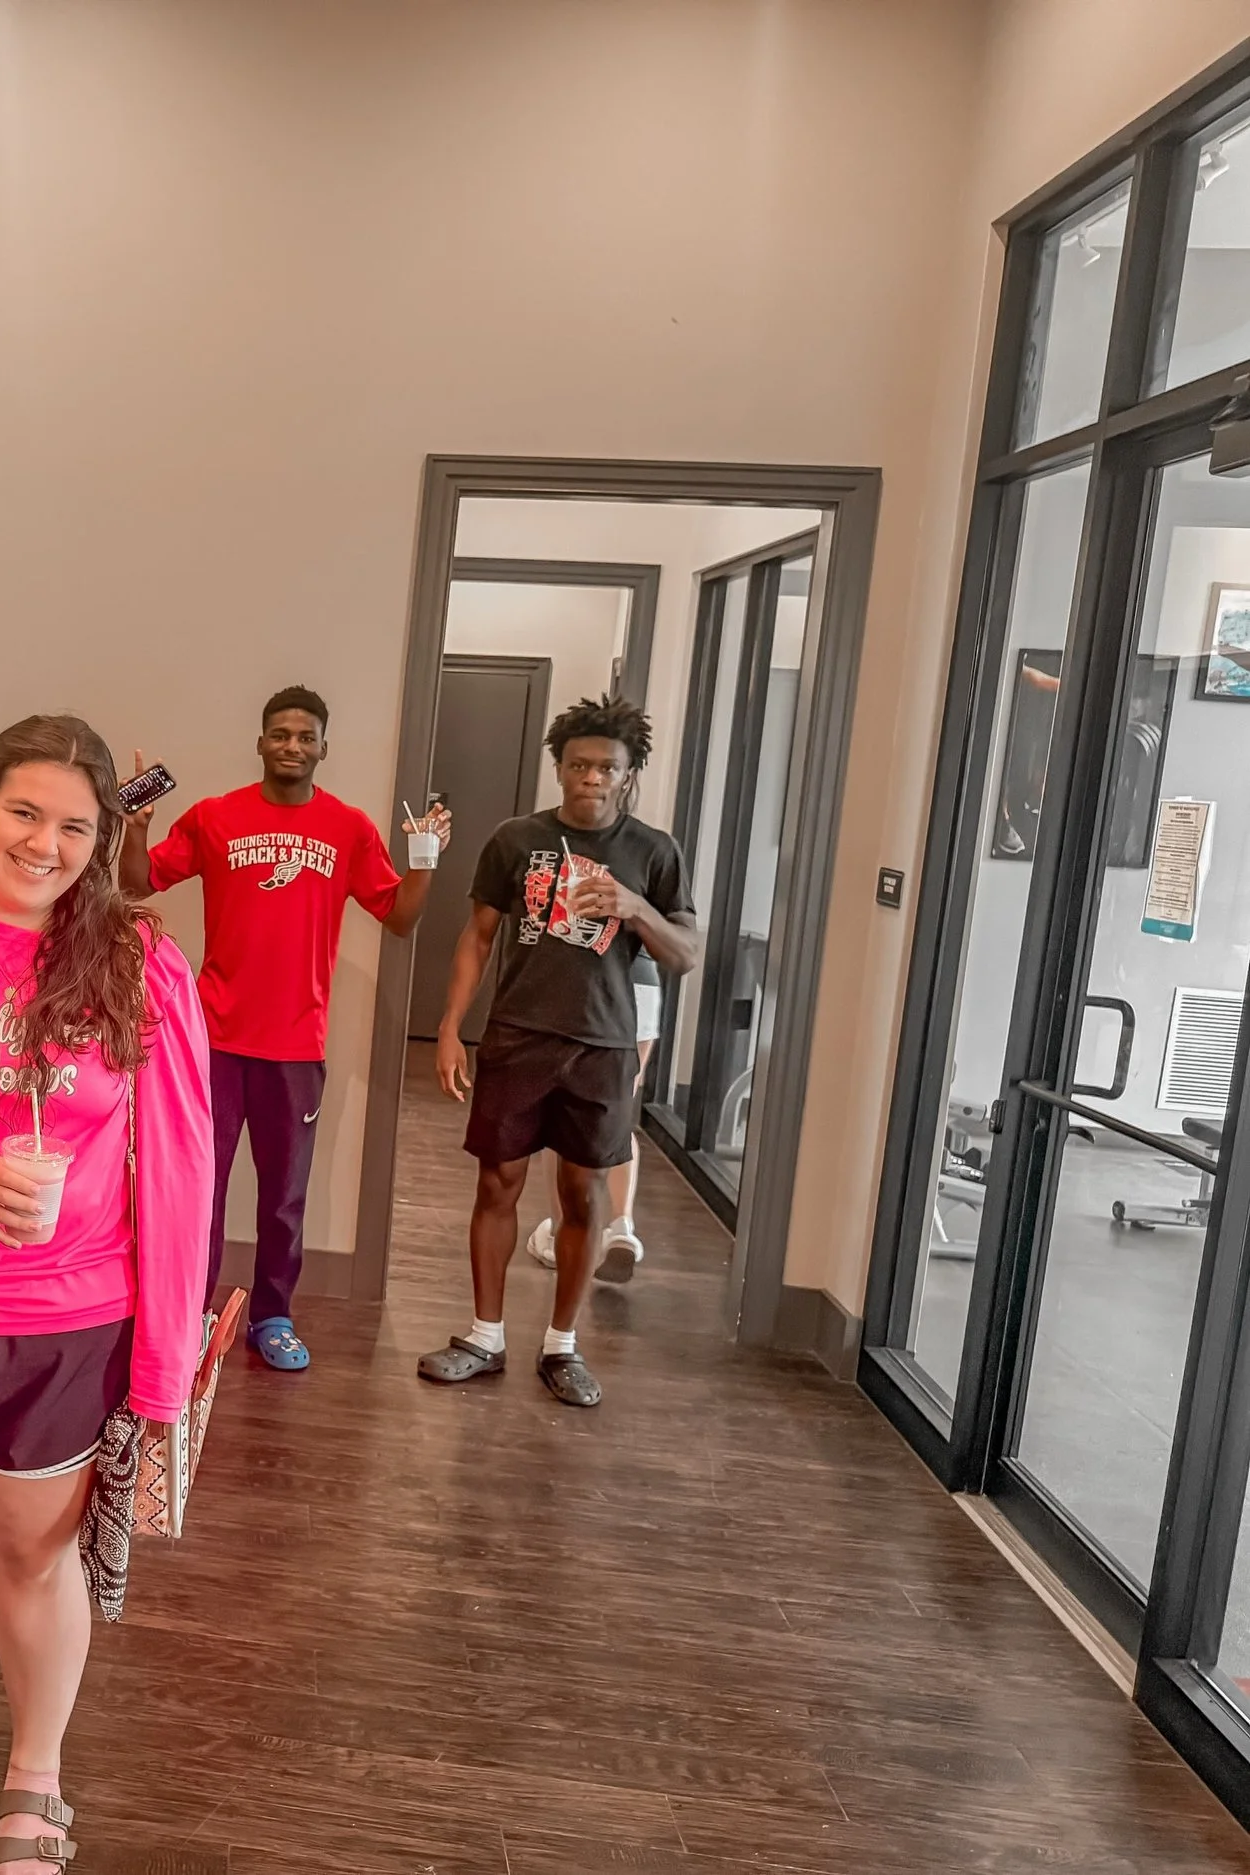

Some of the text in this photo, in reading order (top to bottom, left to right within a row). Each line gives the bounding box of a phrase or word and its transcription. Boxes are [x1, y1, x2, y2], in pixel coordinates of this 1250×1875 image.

[227, 832, 338, 862] YOUNGSTOWN STATE
[227, 845, 335, 879] TRACK & FIELD
